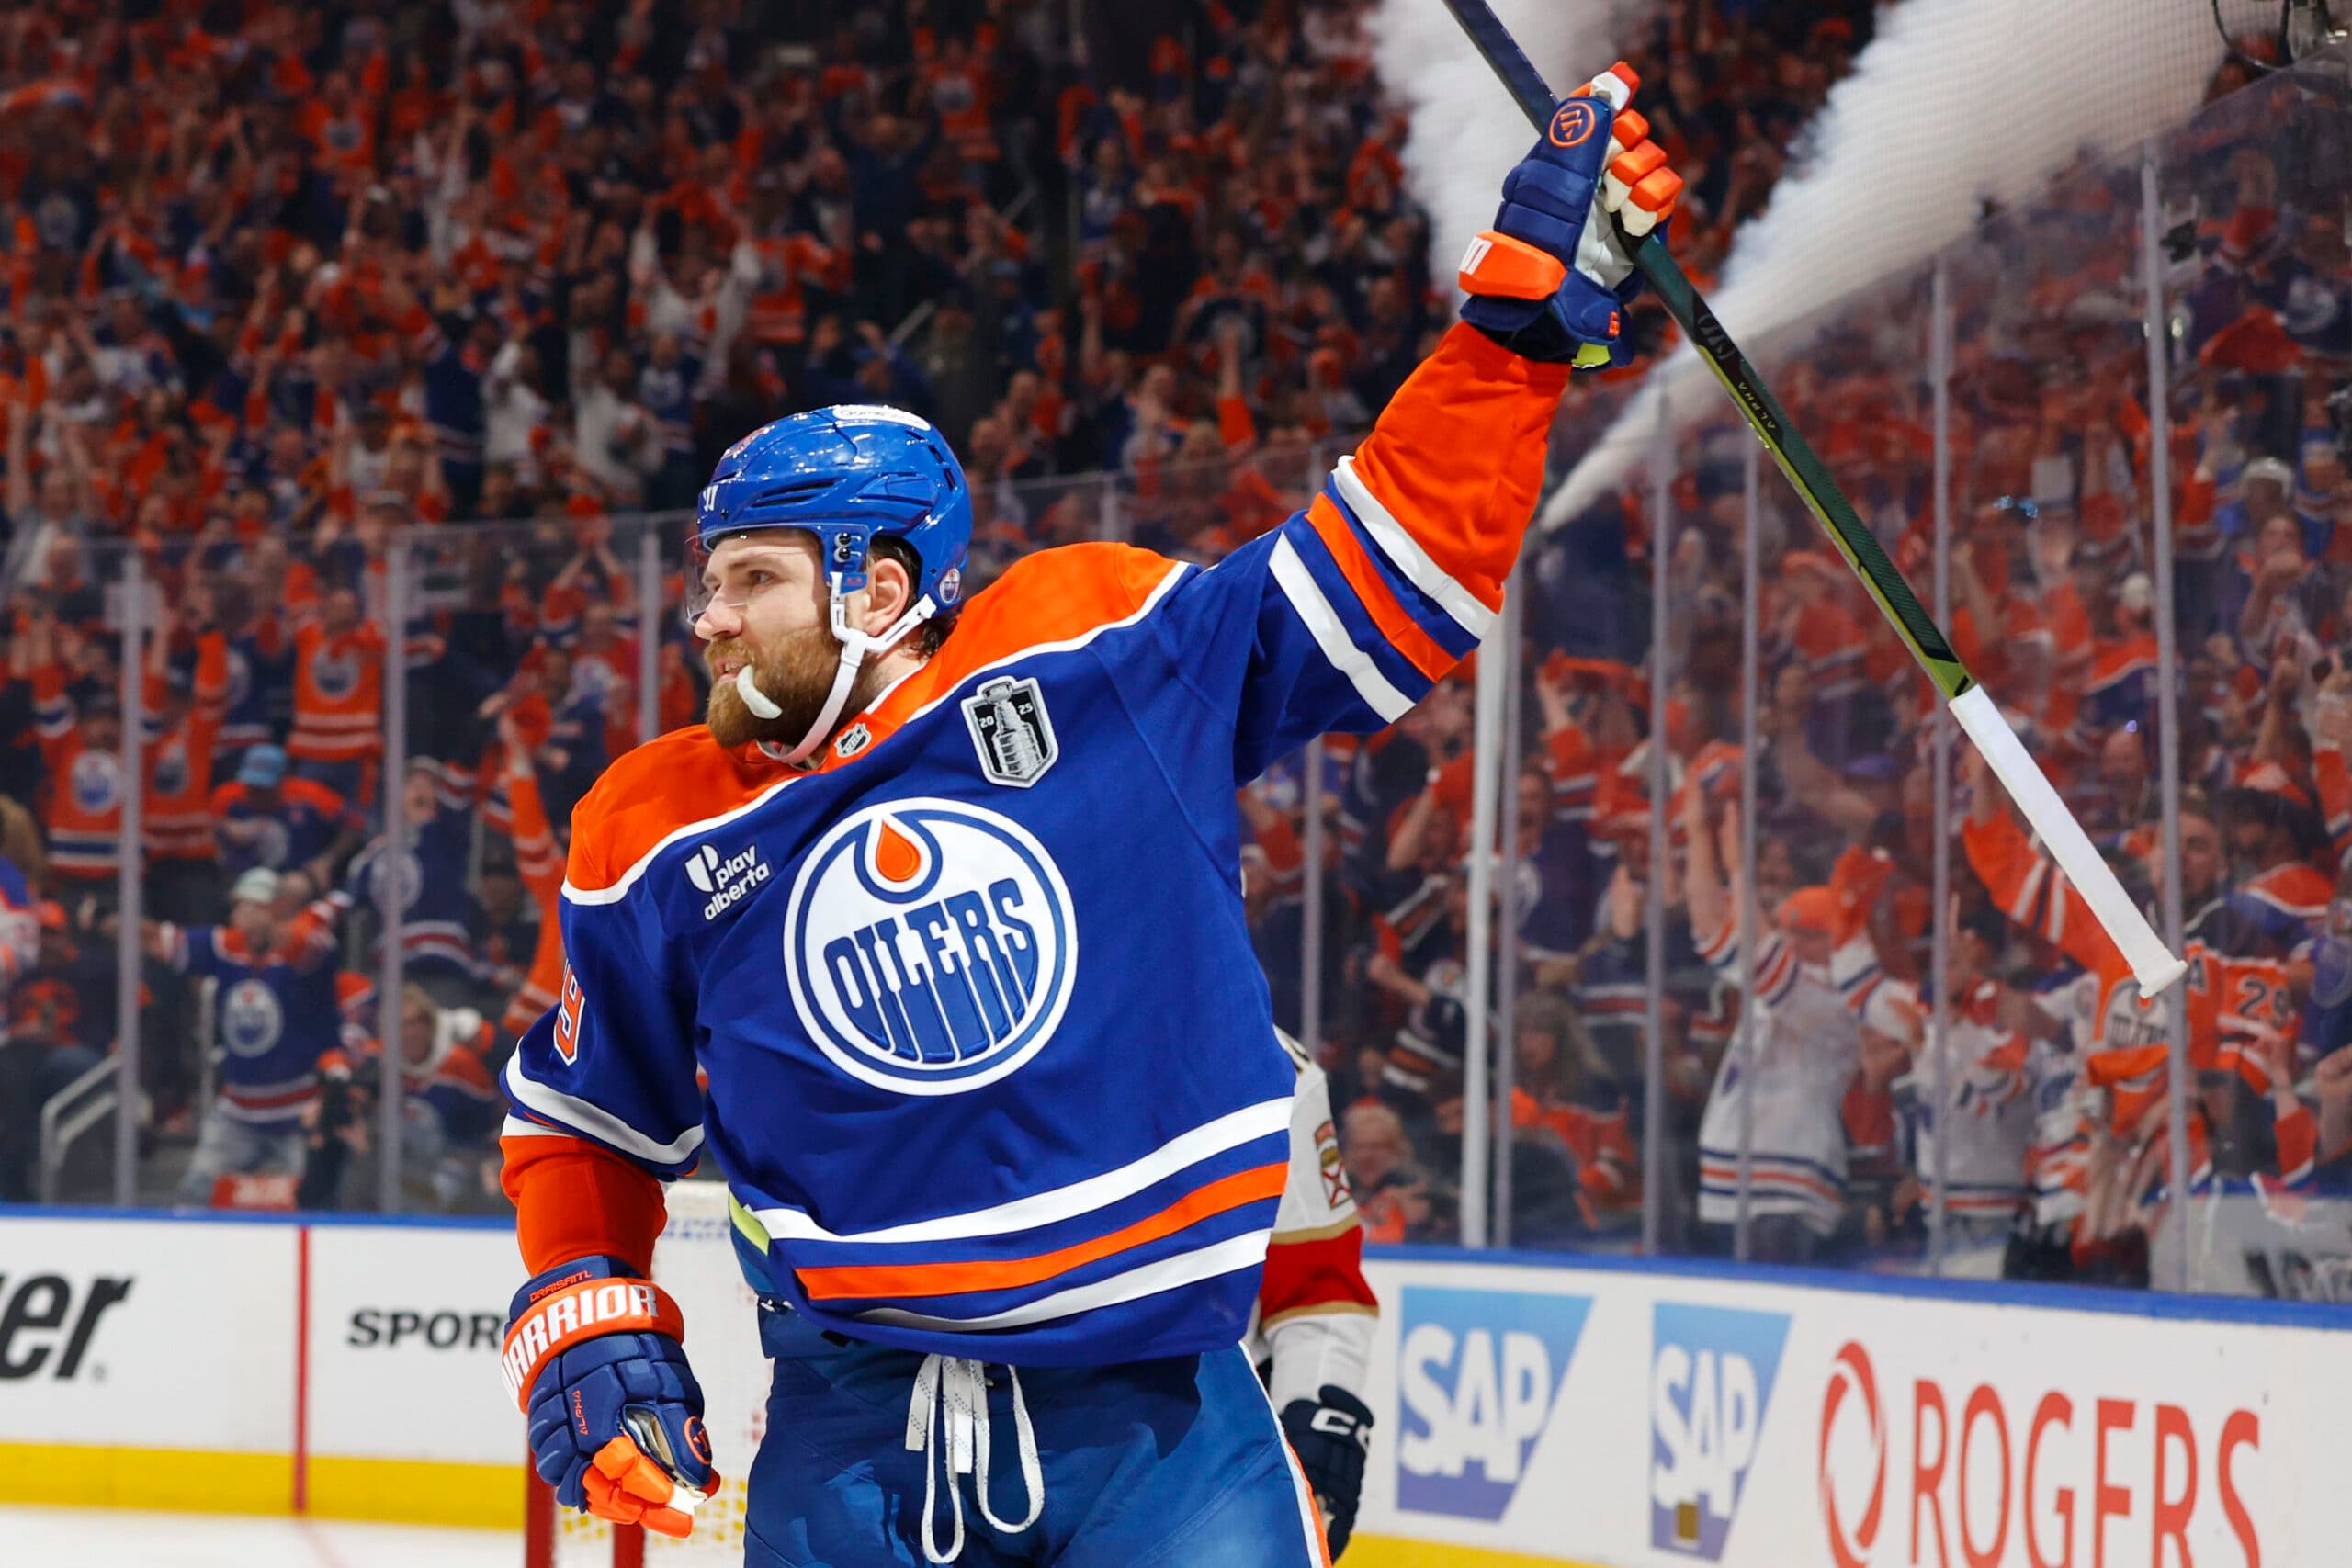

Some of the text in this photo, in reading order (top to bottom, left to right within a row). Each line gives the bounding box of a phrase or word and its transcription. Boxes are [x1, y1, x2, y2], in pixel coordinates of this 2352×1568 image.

[978, 716, 994, 728] 20
[1017, 703, 1034, 716] 25
[704, 863, 770, 920] alberta
[715, 844, 755, 890] play
[823, 877, 1039, 1065] OILERS
[529, 1270, 593, 1303] DRAISAITL
[0, 1274, 133, 1380] er
[348, 1308, 505, 1348] SPOR
[573, 1390, 588, 1435] ALPHA
[1401, 1323, 1550, 1483] SAP
[1653, 1343, 1758, 1519] SAP
[1910, 1377, 2261, 1568] ROGERS
